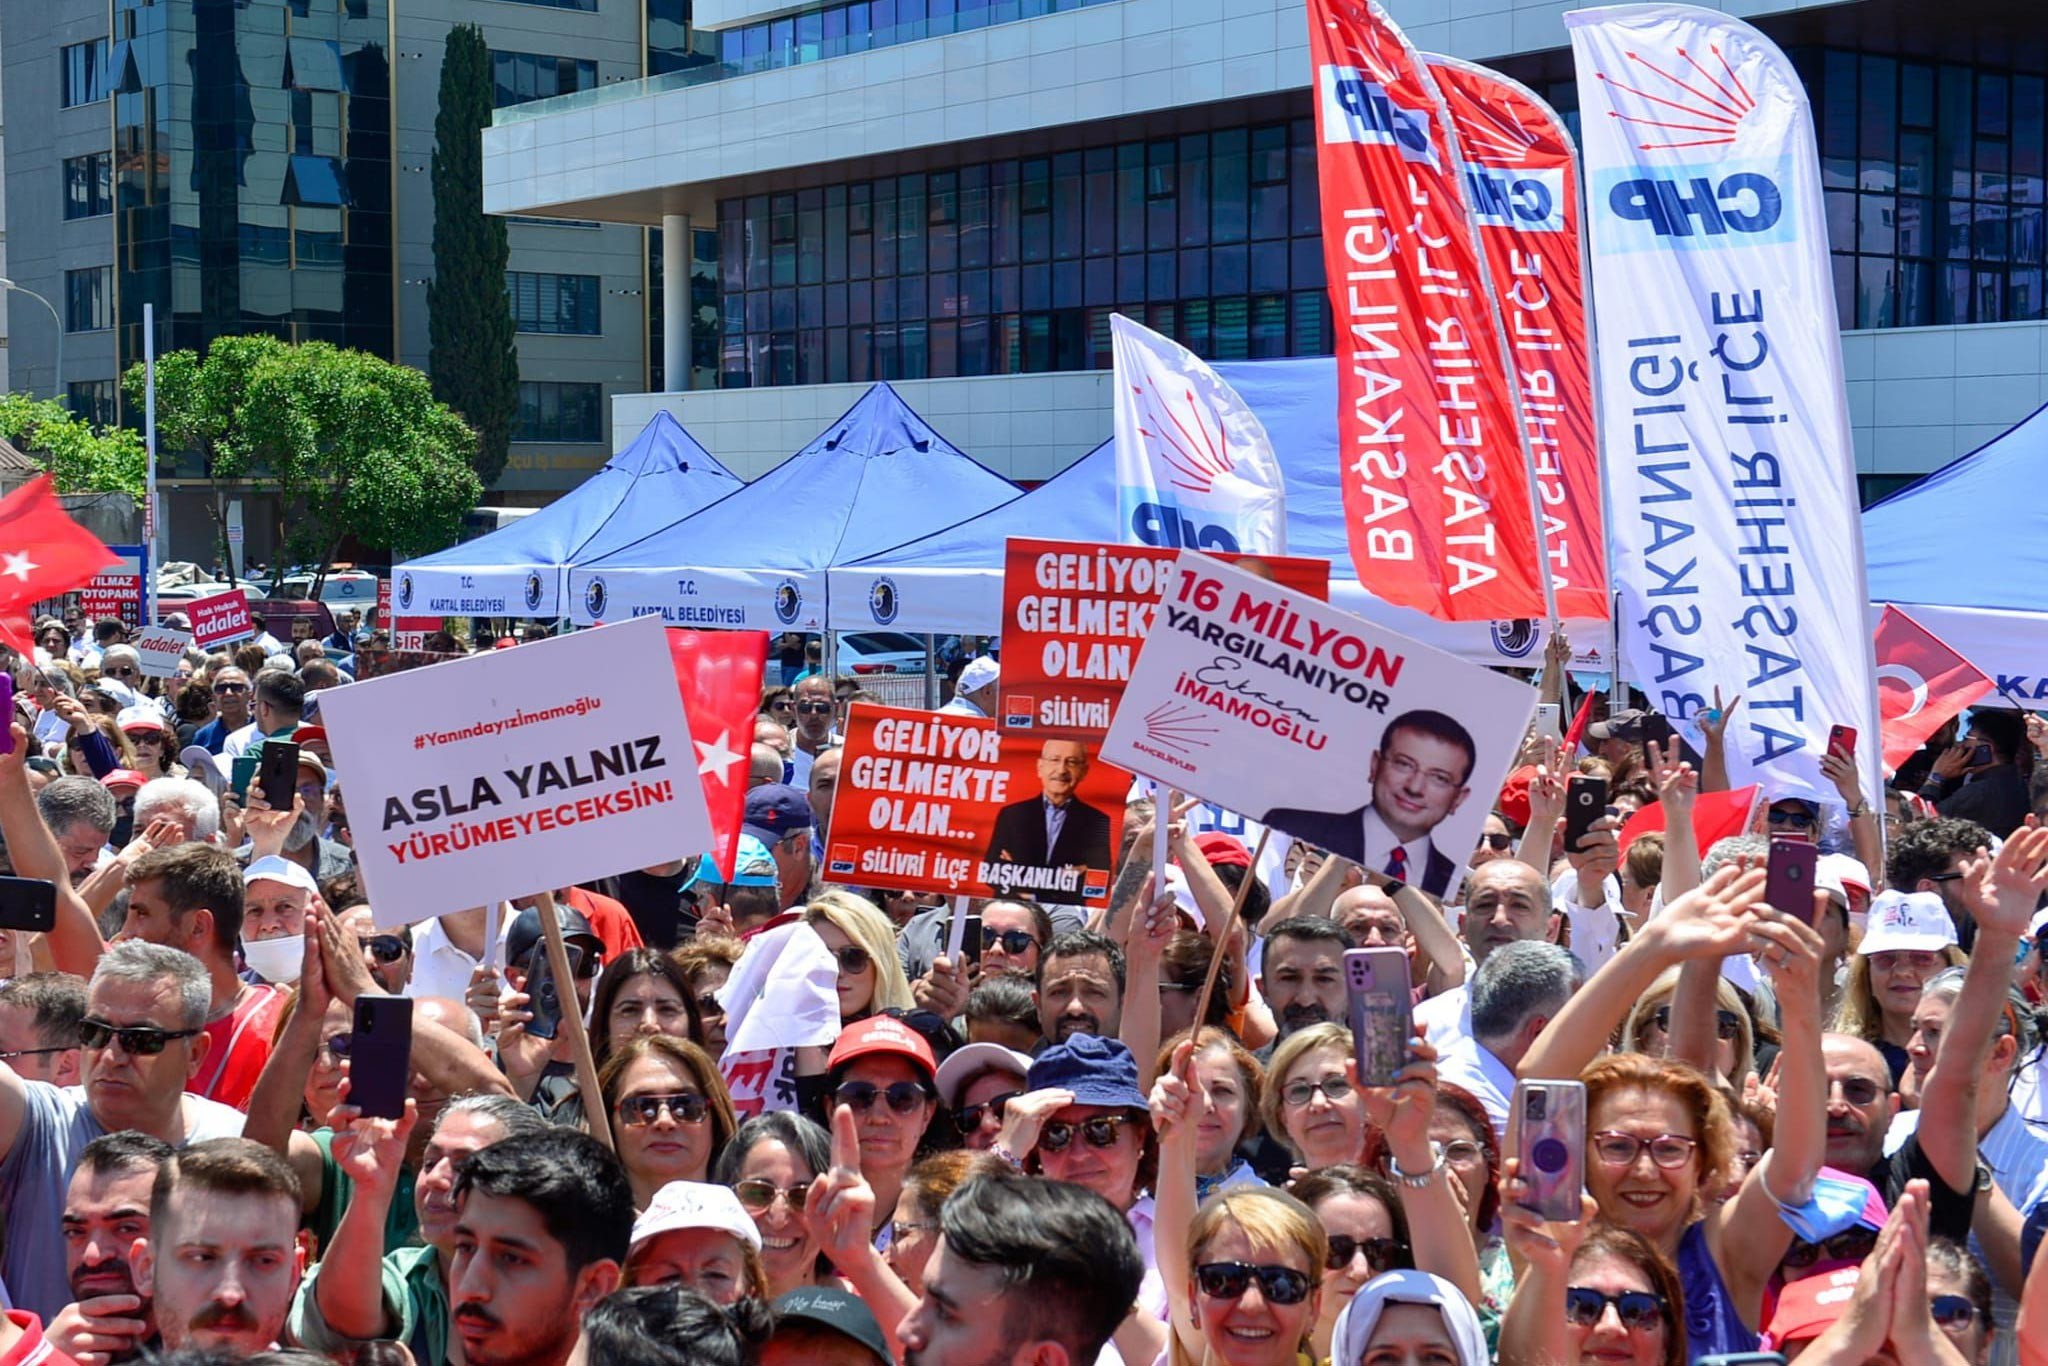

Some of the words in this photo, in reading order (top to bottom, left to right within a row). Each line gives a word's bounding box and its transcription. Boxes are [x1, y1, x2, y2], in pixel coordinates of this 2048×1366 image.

[82, 589, 139, 599] OTOPARK
[90, 576, 133, 587] YILMAZ
[678, 580, 698, 595] T.C.
[196, 609, 247, 637] adalet
[679, 604, 745, 624] BELEDİYESİ
[1017, 596, 1160, 638] GELMEK
[1177, 570, 1224, 613] 16
[1229, 591, 1405, 688] MİLYON
[140, 635, 185, 655] adalet
[1166, 605, 1391, 714] YARGILANIYOR
[414, 696, 601, 750] #Yanındayızİmamoğlu
[1040, 696, 1111, 728] SİLİVRİ
[1174, 671, 1329, 751] İMAMOĞLU
[873, 716, 1001, 763] GELİYOR
[382, 776, 502, 831] ASLA
[504, 735, 666, 800] YALNIZ
[851, 755, 1011, 802] GELMEKTE
[388, 780, 673, 864] YÜRÜMEYECEKSİN!
[869, 797, 976, 840] OLAN...
[862, 846, 927, 878] SİLİVRİ
[933, 852, 971, 889] İLÇE
[977, 860, 1079, 894] BAŞKANLIĞI
